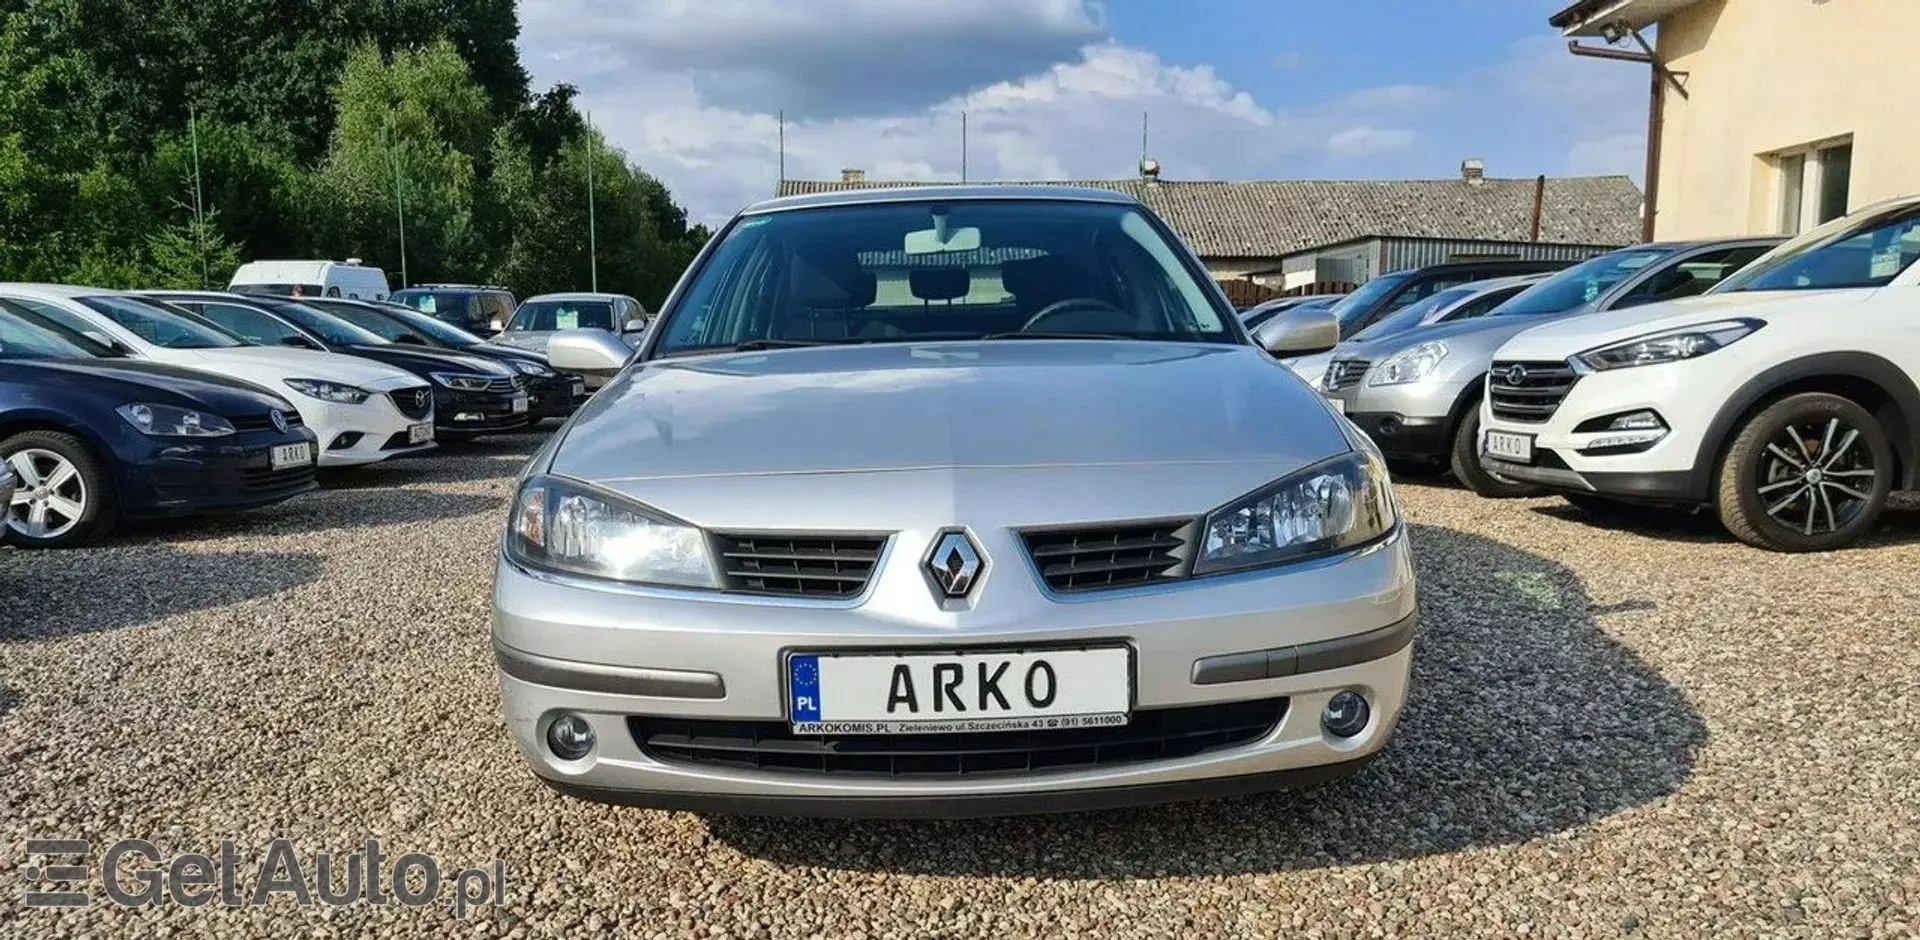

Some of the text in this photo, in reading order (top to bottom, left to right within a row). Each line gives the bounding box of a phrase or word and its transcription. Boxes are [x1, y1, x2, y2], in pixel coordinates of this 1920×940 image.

[1493, 435, 1520, 454] ARKO
[797, 660, 1057, 713] PL ARKO
[799, 722, 892, 733] ARKOKOMIS.PL
[1032, 719, 1044, 727] 43
[1082, 716, 1122, 725] 5611000
